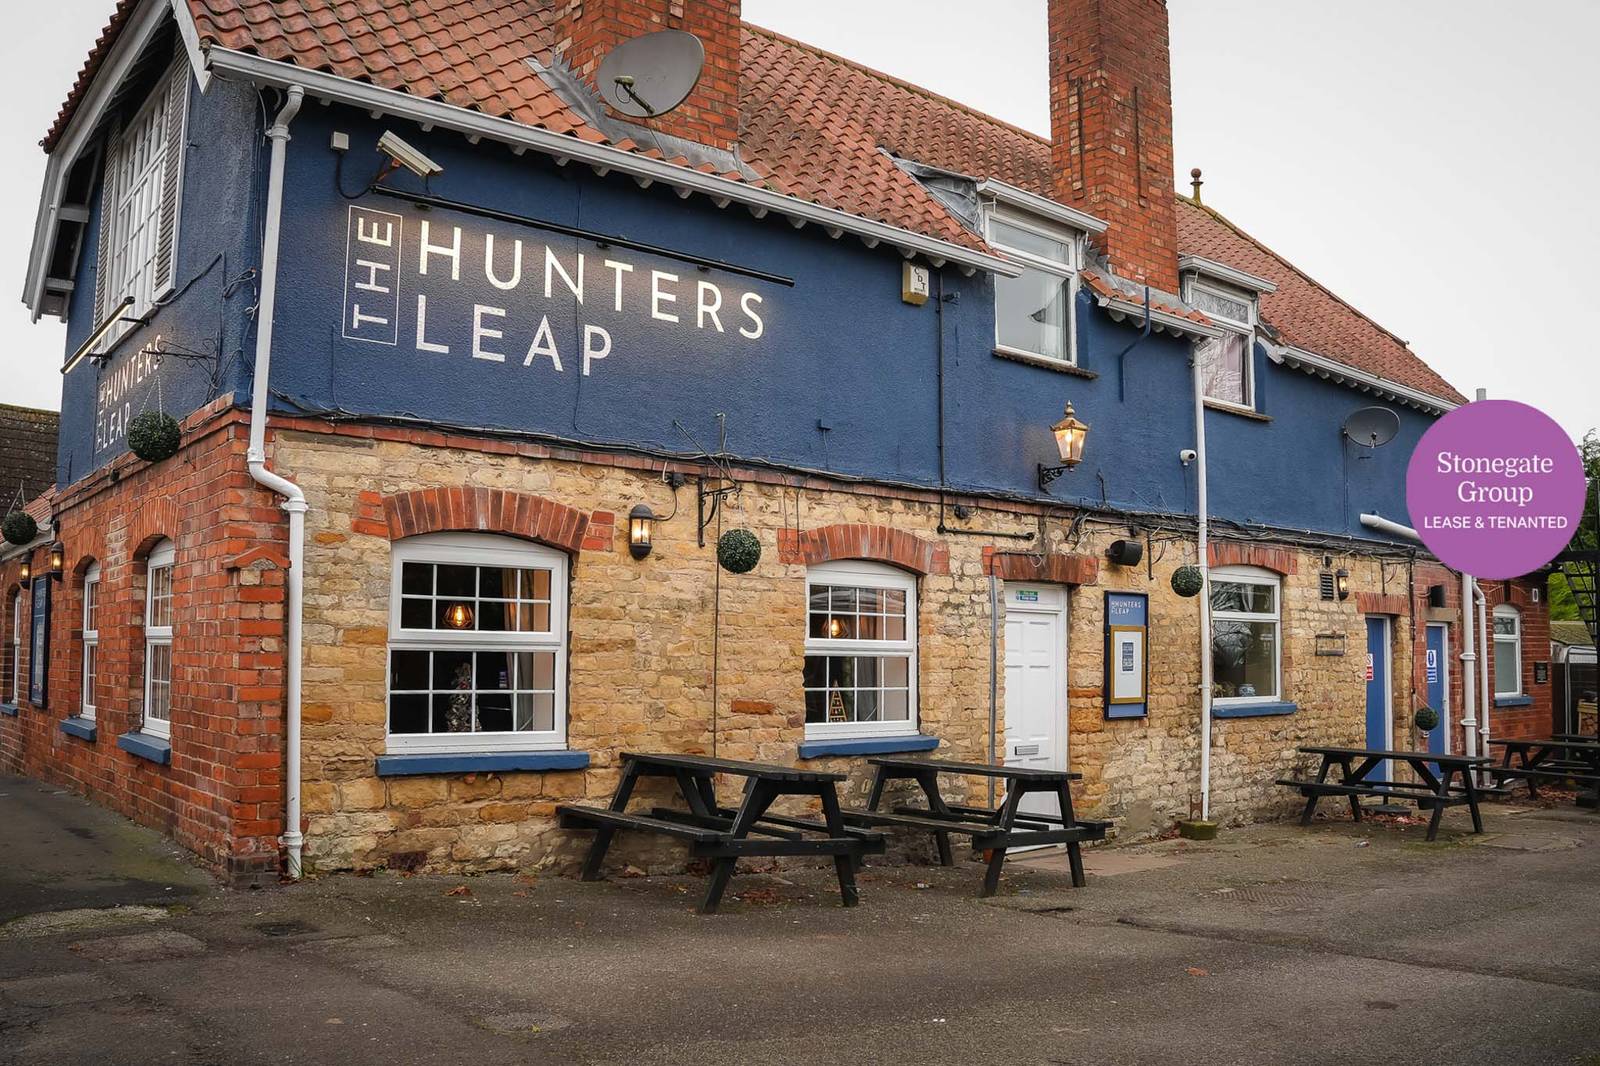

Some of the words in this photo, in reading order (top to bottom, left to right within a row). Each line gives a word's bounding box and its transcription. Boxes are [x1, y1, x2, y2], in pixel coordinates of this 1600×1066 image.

[353, 217, 392, 329] THE
[418, 219, 765, 341] HUNTERS
[105, 334, 161, 409] HUNTERS
[415, 294, 613, 377] LEAP
[102, 402, 131, 449] LEAP
